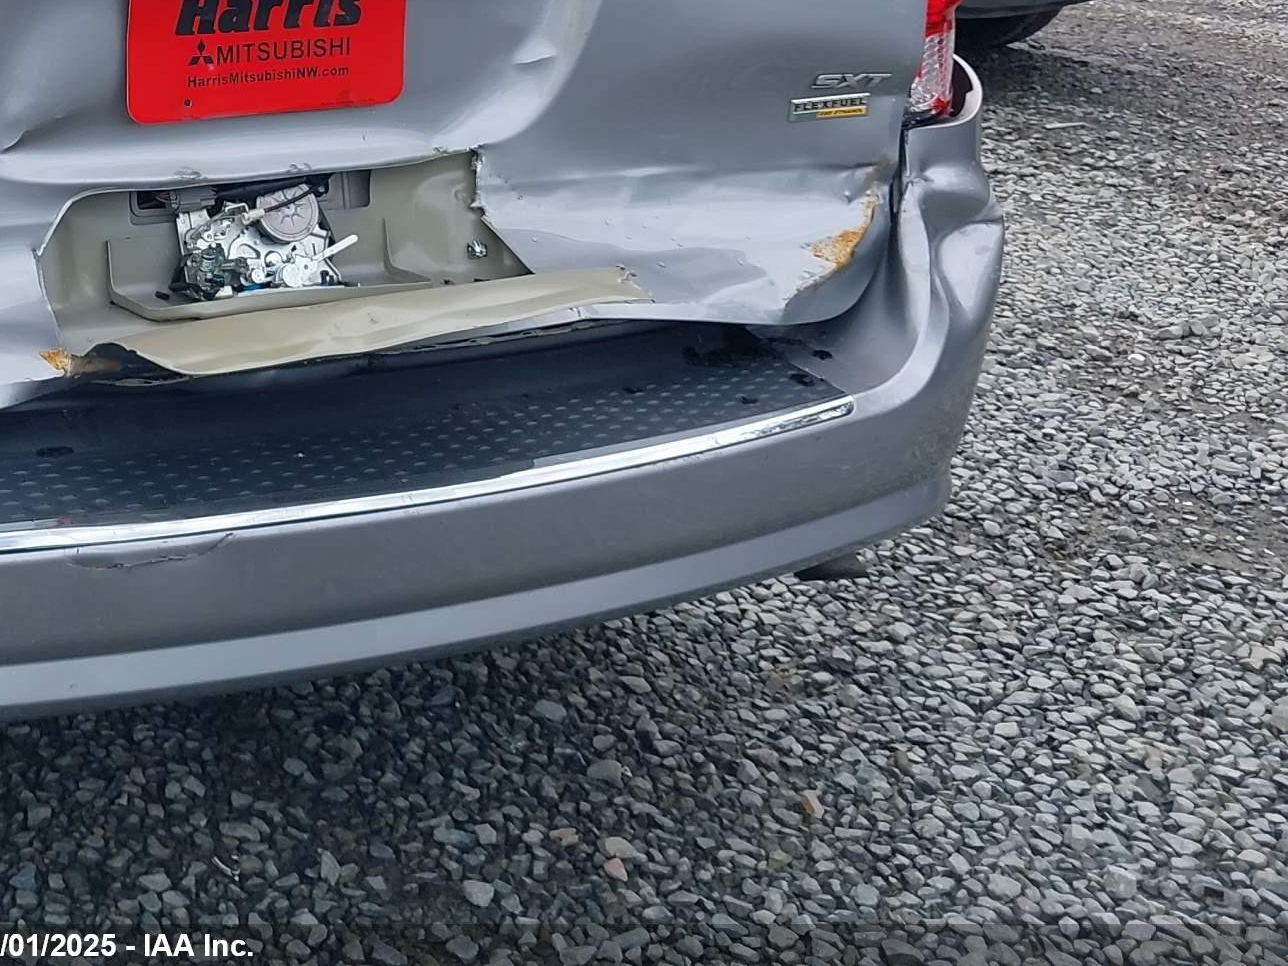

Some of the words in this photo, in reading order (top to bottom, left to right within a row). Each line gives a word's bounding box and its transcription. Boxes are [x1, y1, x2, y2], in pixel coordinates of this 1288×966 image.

[216, 37, 351, 66] MITSUBISHI
[187, 65, 350, 88] HarrisMitsubishiNW.com
[811, 72, 892, 89] SXT
